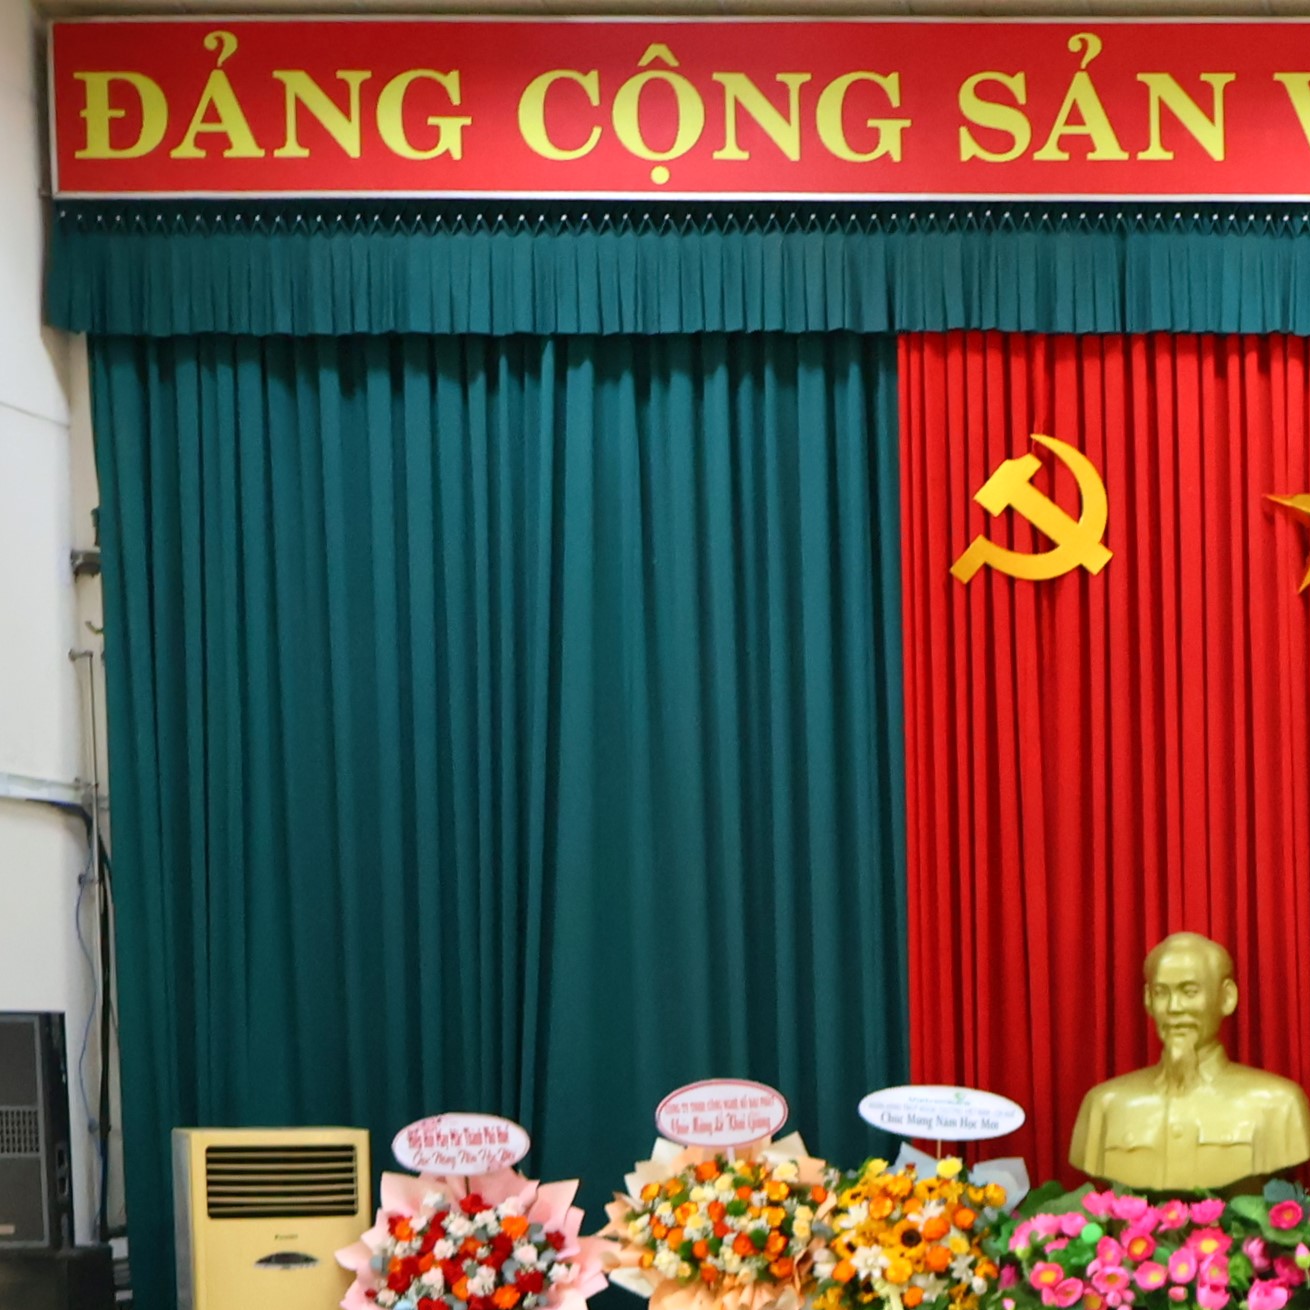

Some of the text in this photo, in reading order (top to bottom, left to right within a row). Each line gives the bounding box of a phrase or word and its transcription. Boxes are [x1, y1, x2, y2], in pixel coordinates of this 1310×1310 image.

[75, 31, 472, 161] ĐẢNG
[517, 44, 912, 185] CỘNG
[958, 33, 1236, 163] SẢN
